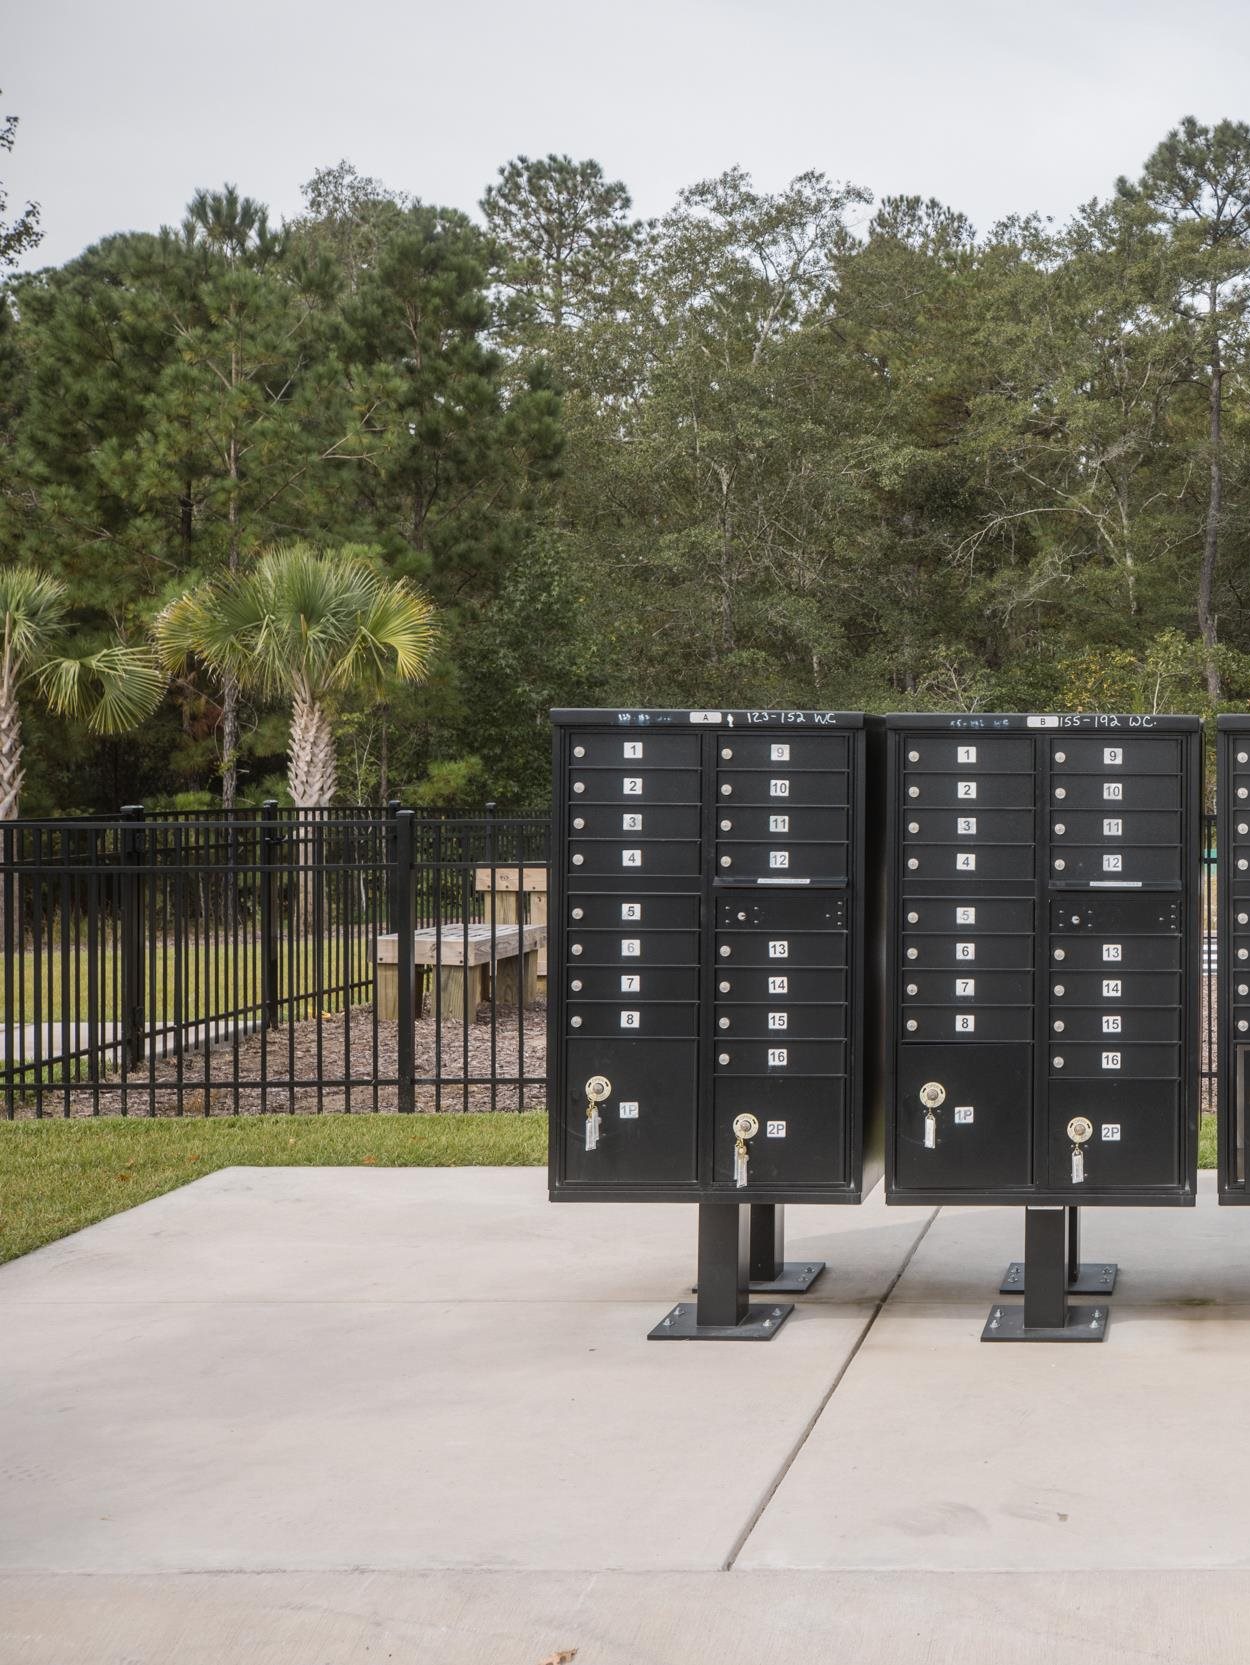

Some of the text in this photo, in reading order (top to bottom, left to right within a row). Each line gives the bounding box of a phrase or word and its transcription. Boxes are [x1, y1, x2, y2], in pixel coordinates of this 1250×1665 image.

[702, 713, 709, 721] A
[747, 712, 806, 724] 123-152
[1040, 717, 1046, 726] B
[1060, 715, 1121, 728] 155-192
[776, 746, 785, 758] 9
[1109, 750, 1117, 762] 9
[629, 780, 637, 792] 2
[771, 782, 787, 794] 10
[963, 784, 972, 796] 2
[1104, 785, 1120, 797] 10
[628, 816, 637, 828] 3
[772, 818, 787, 830] 11
[962, 820, 971, 832] 3
[1105, 821, 1120, 833] 11
[627, 852, 636, 864] 4
[771, 854, 787, 866] 12
[961, 856, 970, 868] 4
[1104, 857, 1120, 869] 12
[627, 905, 636, 917] 5
[961, 909, 970, 921] 5
[626, 942, 635, 954] 6
[770, 943, 786, 955] 13
[961, 945, 970, 957] 6
[1104, 946, 1120, 958] 13
[626, 977, 635, 989] 7
[770, 979, 786, 991] 14
[961, 981, 969, 993] 7
[1104, 982, 1120, 994] 14
[626, 1013, 634, 1025] 8
[769, 1015, 785, 1027] 15
[961, 1017, 969, 1029] 8
[1104, 1018, 1120, 1030] 15
[769, 1051, 785, 1063] 16
[1103, 1054, 1119, 1066] 16
[621, 1104, 637, 1116] 1P
[956, 1109, 972, 1121] 1P
[768, 1123, 785, 1135] 2P
[1103, 1126, 1120, 1138] 2P
